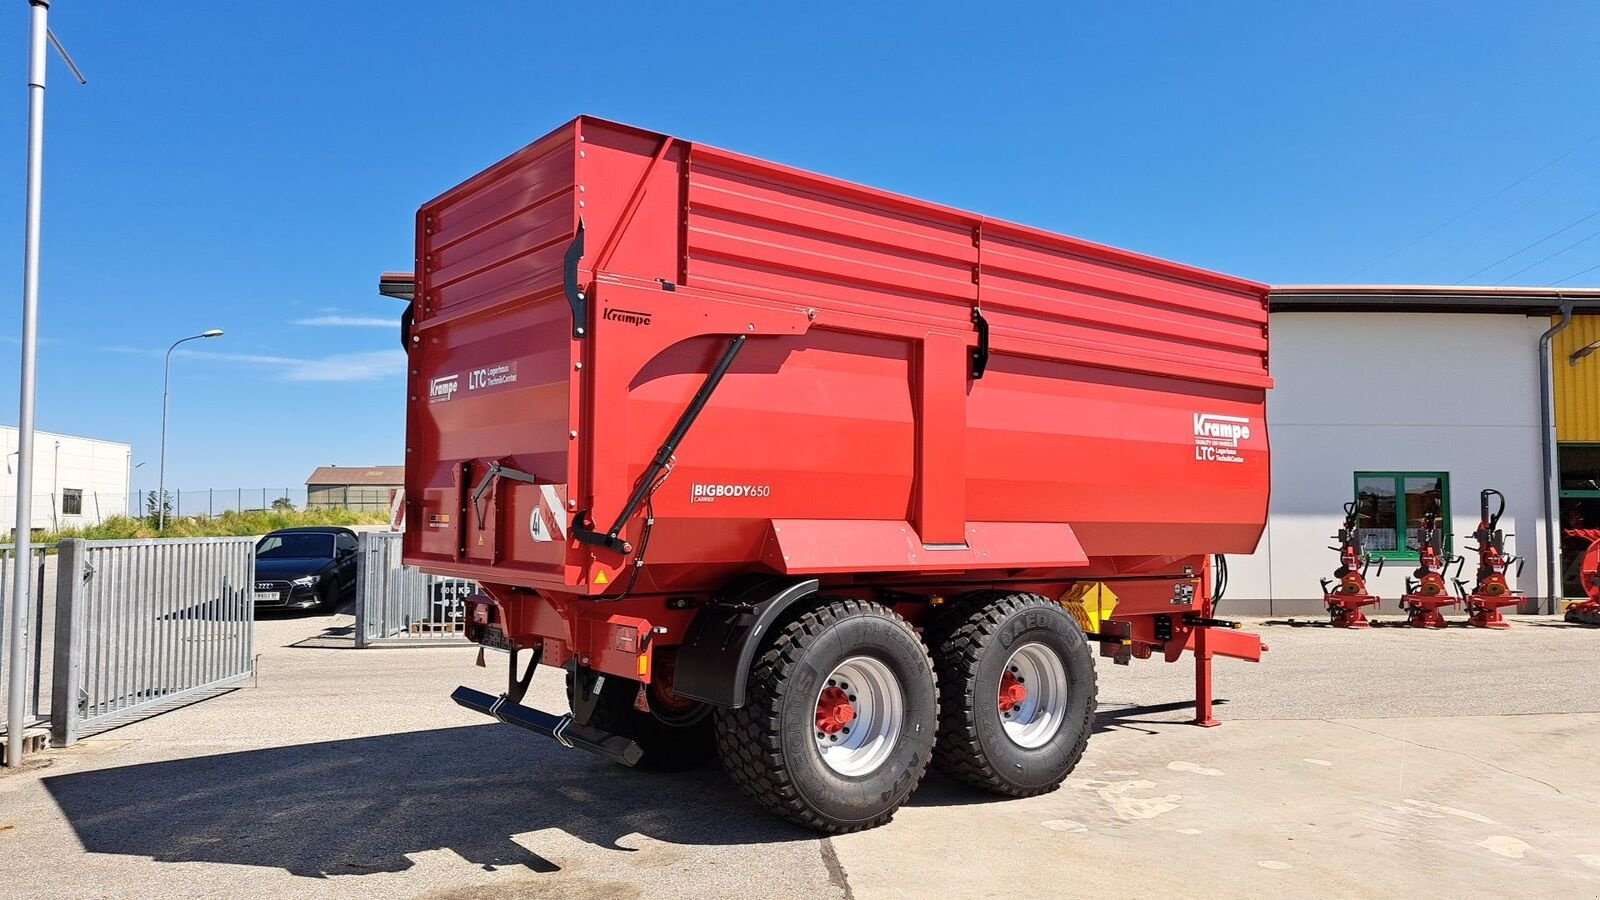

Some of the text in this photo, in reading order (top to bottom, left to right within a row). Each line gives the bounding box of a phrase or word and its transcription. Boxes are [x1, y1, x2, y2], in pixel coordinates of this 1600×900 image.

[603, 307, 651, 326] Krampe
[430, 374, 459, 400] Krampe
[469, 369, 486, 390] LTC
[1193, 412, 1250, 447] Krampe
[1195, 445, 1215, 461] LTC
